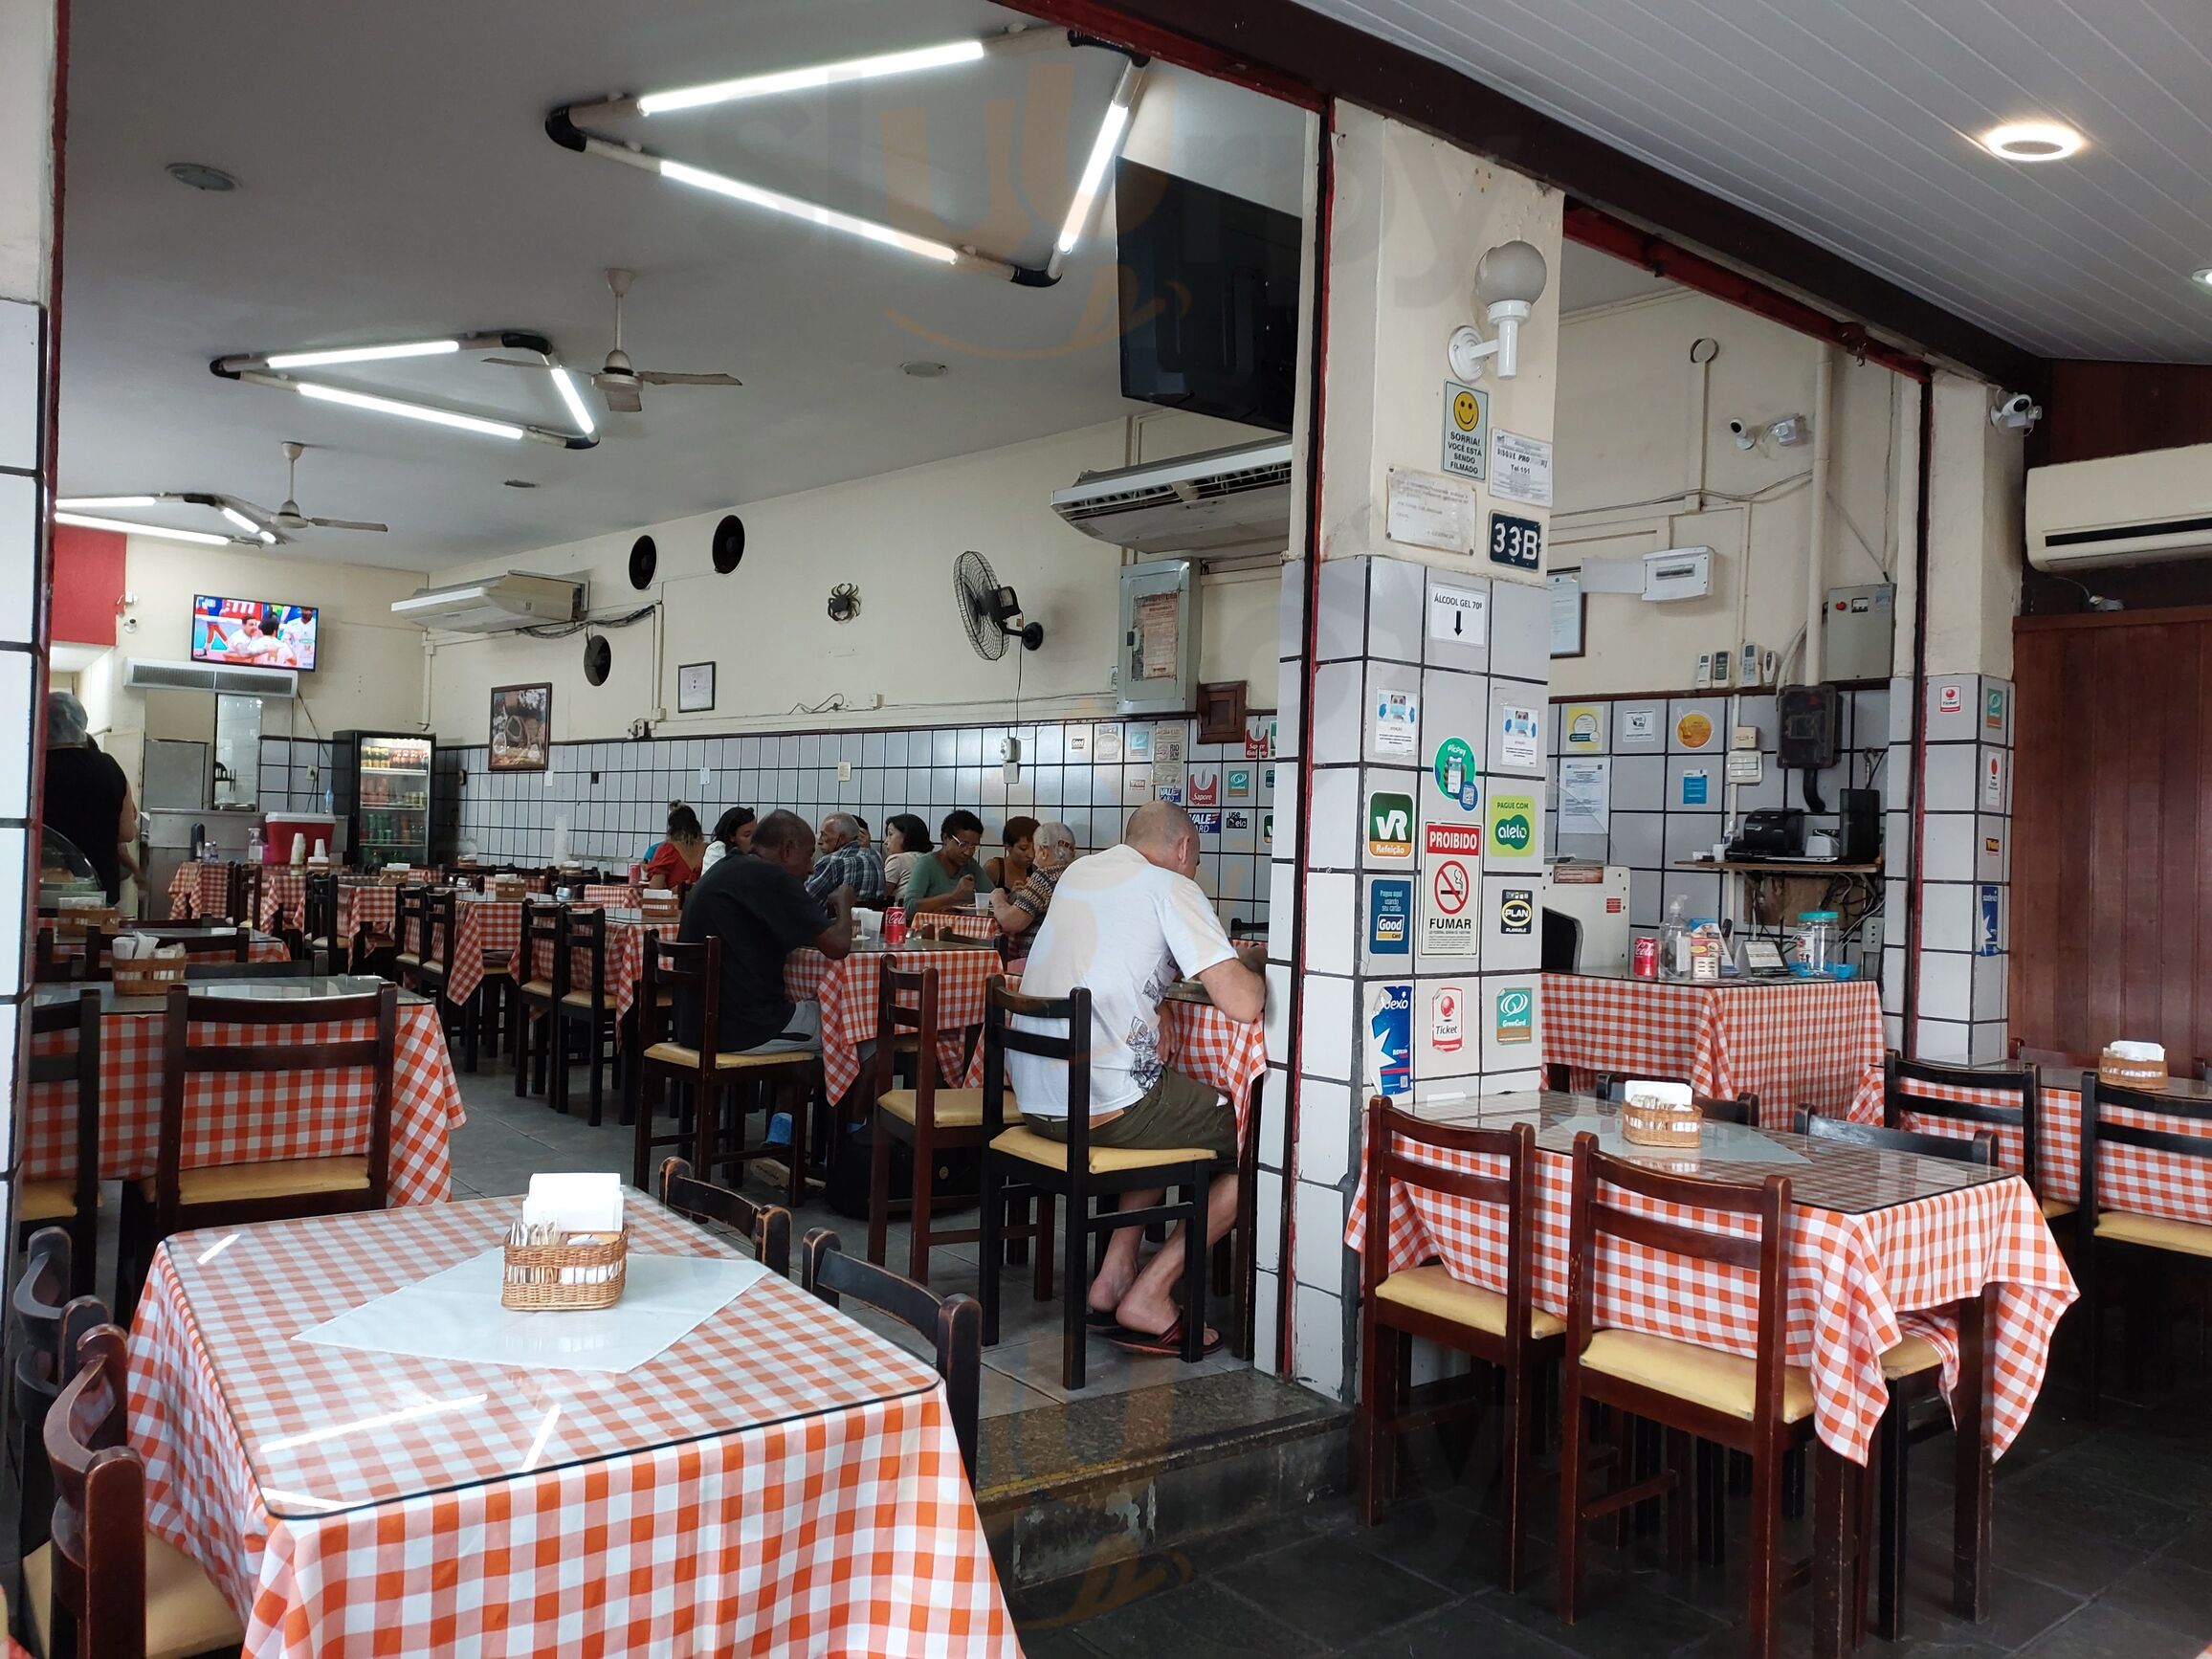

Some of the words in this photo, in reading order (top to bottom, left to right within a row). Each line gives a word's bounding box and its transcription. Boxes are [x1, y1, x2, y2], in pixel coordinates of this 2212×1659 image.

[1450, 431, 1480, 446] SORRIA!
[1448, 442, 1465, 452] VOCÊ
[1467, 447, 1482, 456] ESTÁ
[1453, 453, 1475, 464] SENDO
[1450, 461, 1478, 475] FILMADO
[1493, 522, 1538, 561] 33B
[1434, 592, 1458, 607] ÁLCOOL
[1460, 599, 1471, 608] GEL
[1375, 809, 1408, 841] VR
[1498, 825, 1528, 839] alelo
[1429, 831, 1478, 850] PROIBIDO
[1376, 845, 1405, 854] Refeição
[1505, 909, 1528, 918] PLAN
[1379, 918, 1403, 931] Good
[1429, 918, 1471, 929] FUMAR
[1435, 1025, 1458, 1034] Ticket
